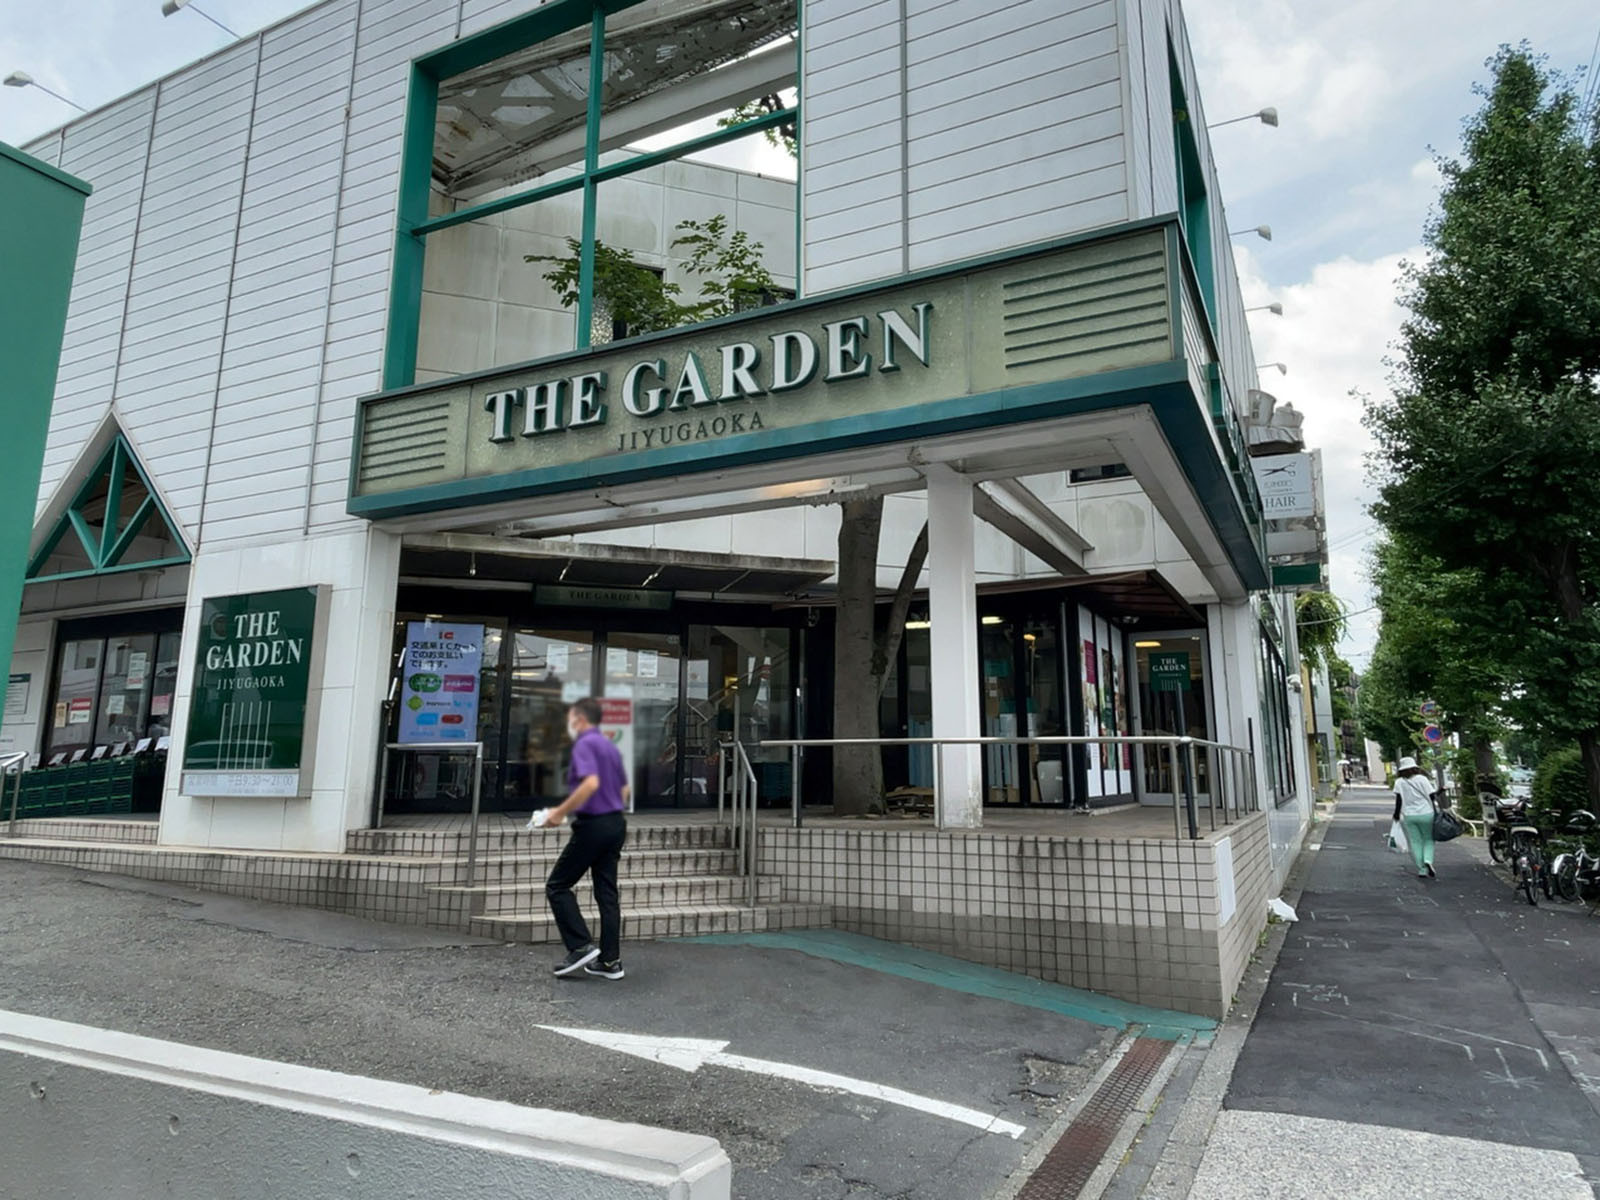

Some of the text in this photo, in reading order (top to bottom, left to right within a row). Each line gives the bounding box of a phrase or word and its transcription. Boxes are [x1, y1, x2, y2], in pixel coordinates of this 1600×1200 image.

[485, 302, 934, 443] THE GARDEN
[617, 410, 764, 452] JIYUGAOKA
[1264, 496, 1296, 508] HAIR
[569, 591, 641, 601] THE GARDEN
[234, 610, 281, 639] THE
[206, 638, 303, 671] GARDEN
[410, 659, 449, 669] です。
[216, 675, 285, 690] JIYUGAOKA
